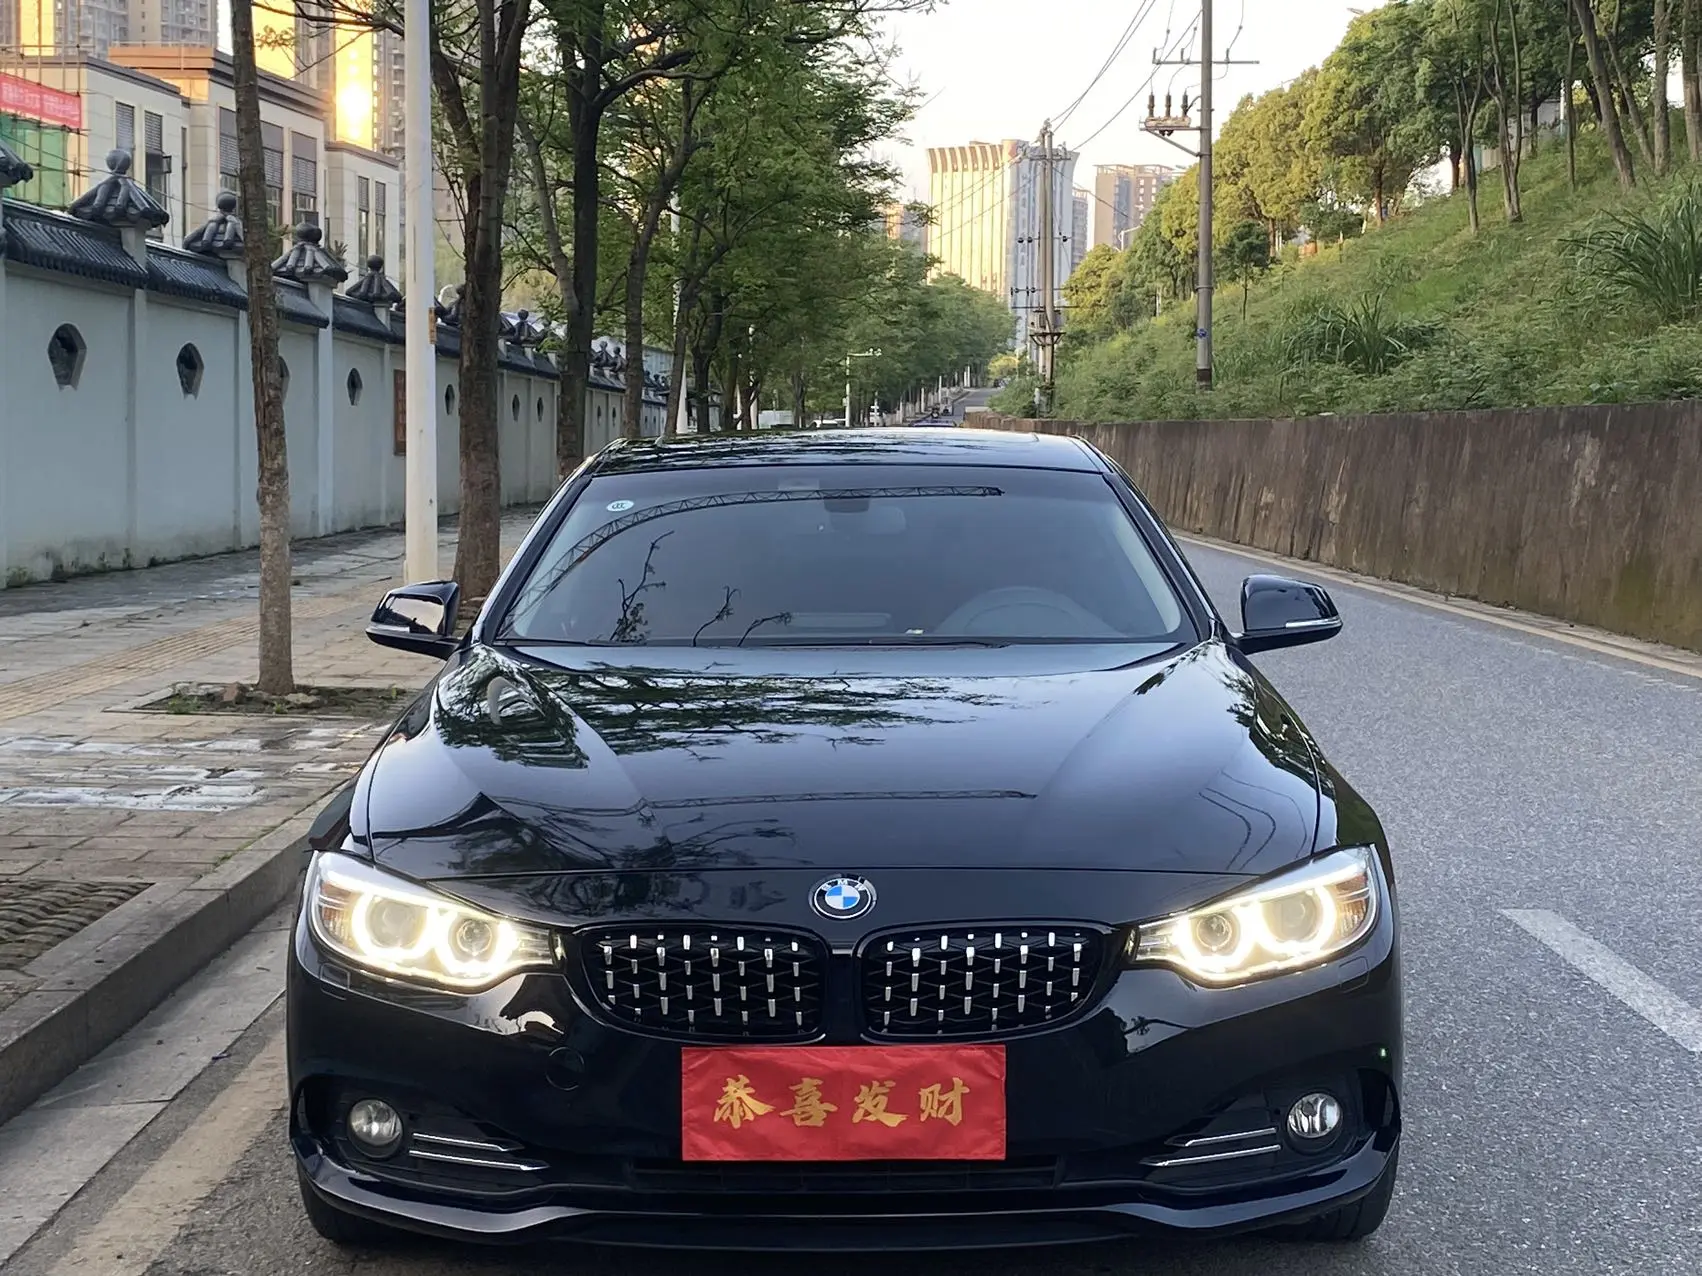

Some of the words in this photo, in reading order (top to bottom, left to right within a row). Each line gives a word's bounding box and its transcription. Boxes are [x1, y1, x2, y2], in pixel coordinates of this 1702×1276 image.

[820, 878, 866, 891] BMW
[713, 1074, 970, 1129] 恭喜发财
